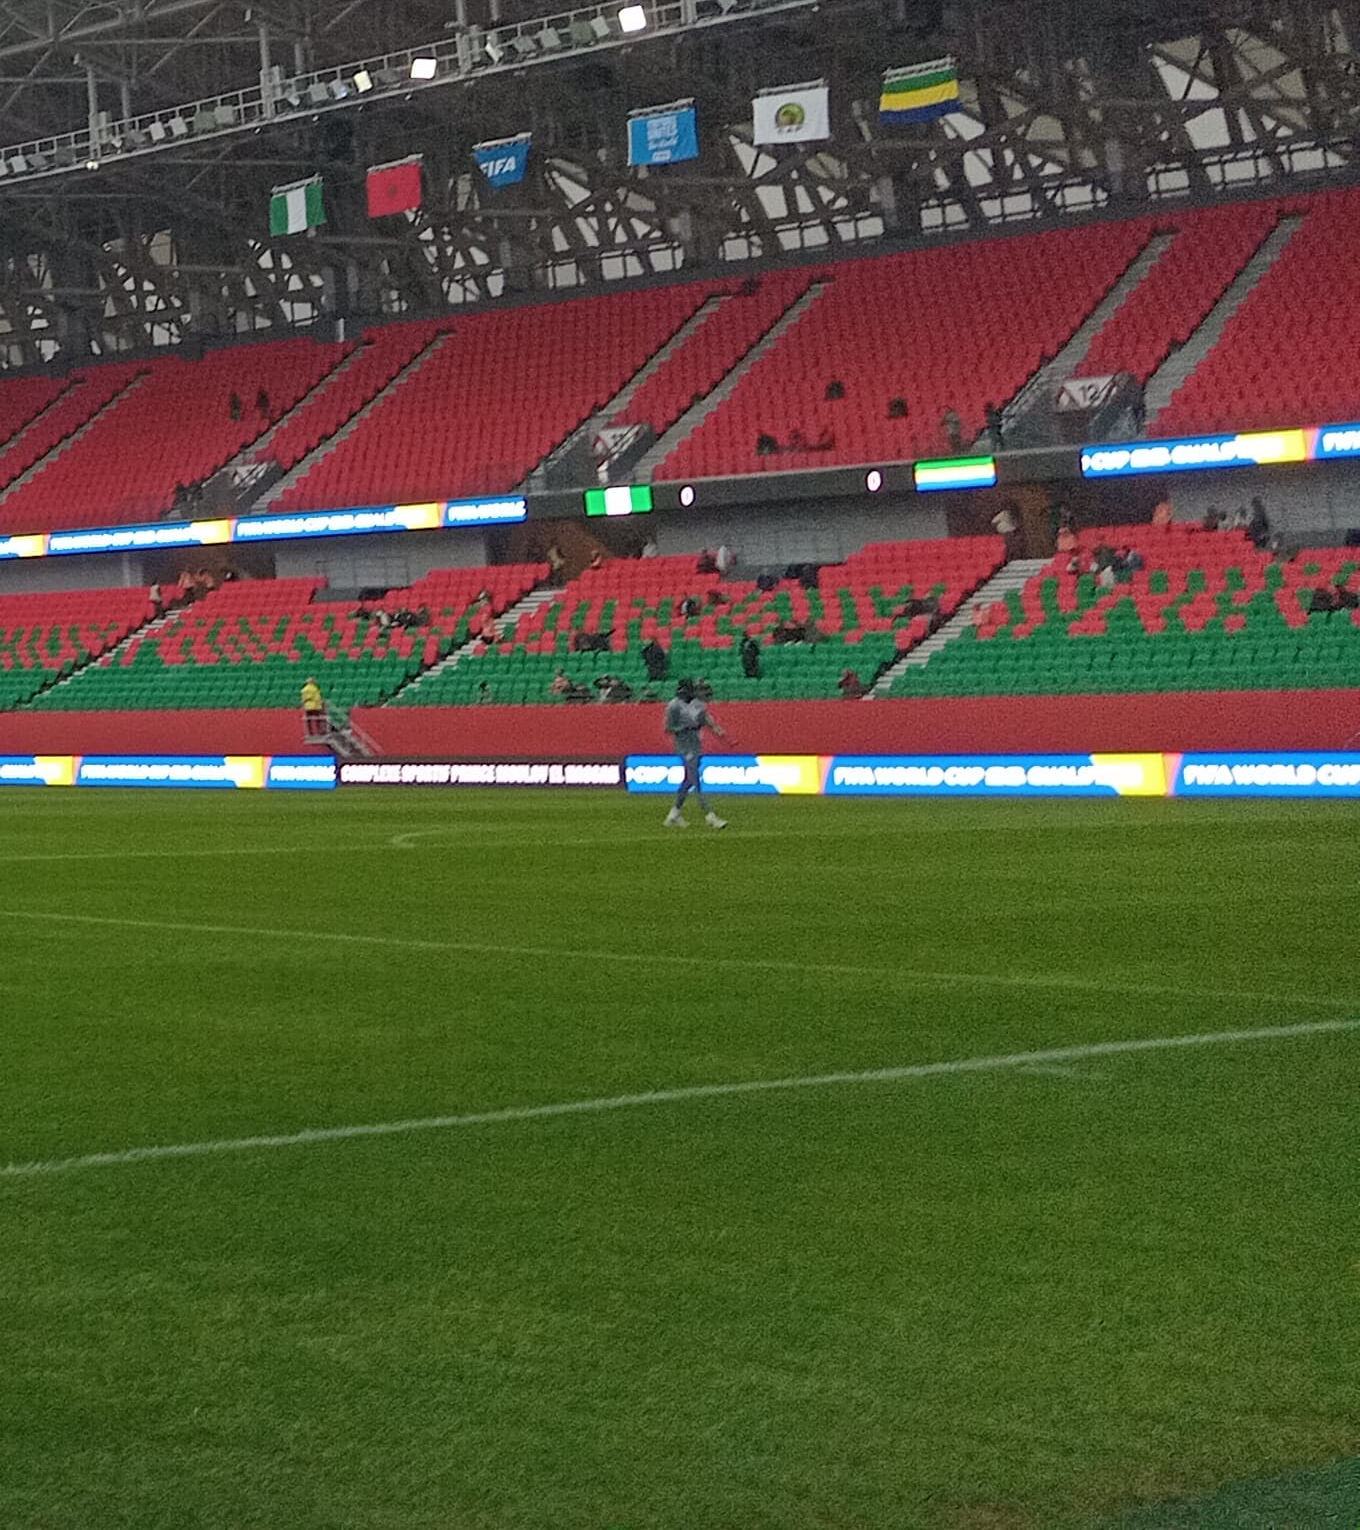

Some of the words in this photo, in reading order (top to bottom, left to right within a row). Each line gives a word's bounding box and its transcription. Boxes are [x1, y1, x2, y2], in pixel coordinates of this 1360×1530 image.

[480, 156, 516, 178] FIFA
[833, 766, 874, 785] FIFA
[875, 766, 944, 785] WORLD
[1183, 764, 1233, 785] FIFA
[1233, 764, 1317, 785] WORLD
